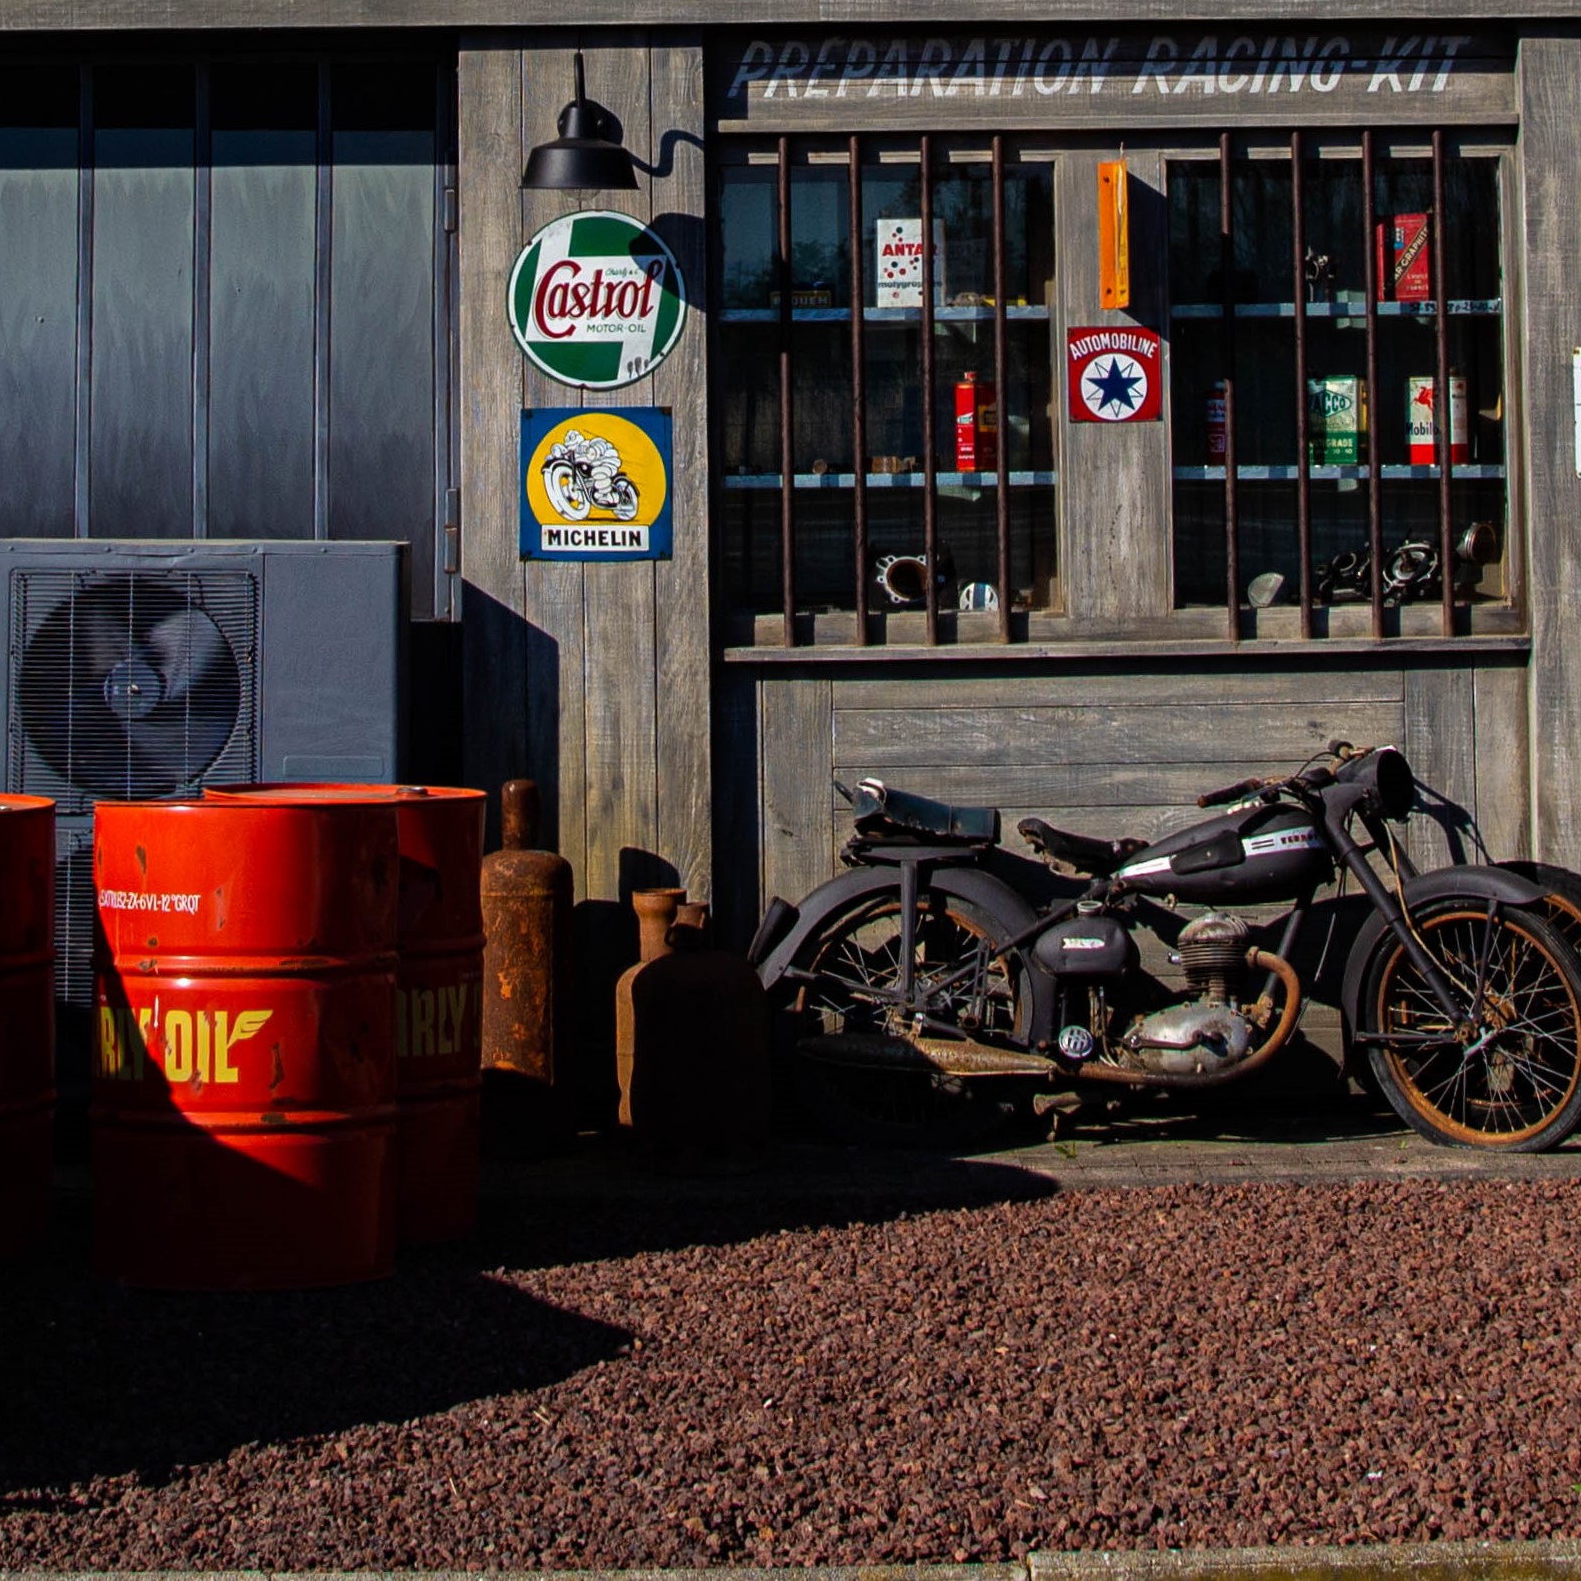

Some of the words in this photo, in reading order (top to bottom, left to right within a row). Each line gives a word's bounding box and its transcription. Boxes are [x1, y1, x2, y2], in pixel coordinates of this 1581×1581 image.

[727, 35, 1120, 99] PRÉPARATION
[1131, 32, 1473, 97] RACING-KIT
[534, 257, 665, 340] Castrol
[1069, 332, 1158, 361] AUTOMOBILINE
[547, 528, 642, 547] MICHELIN
[164, 1008, 240, 1082] OIL
